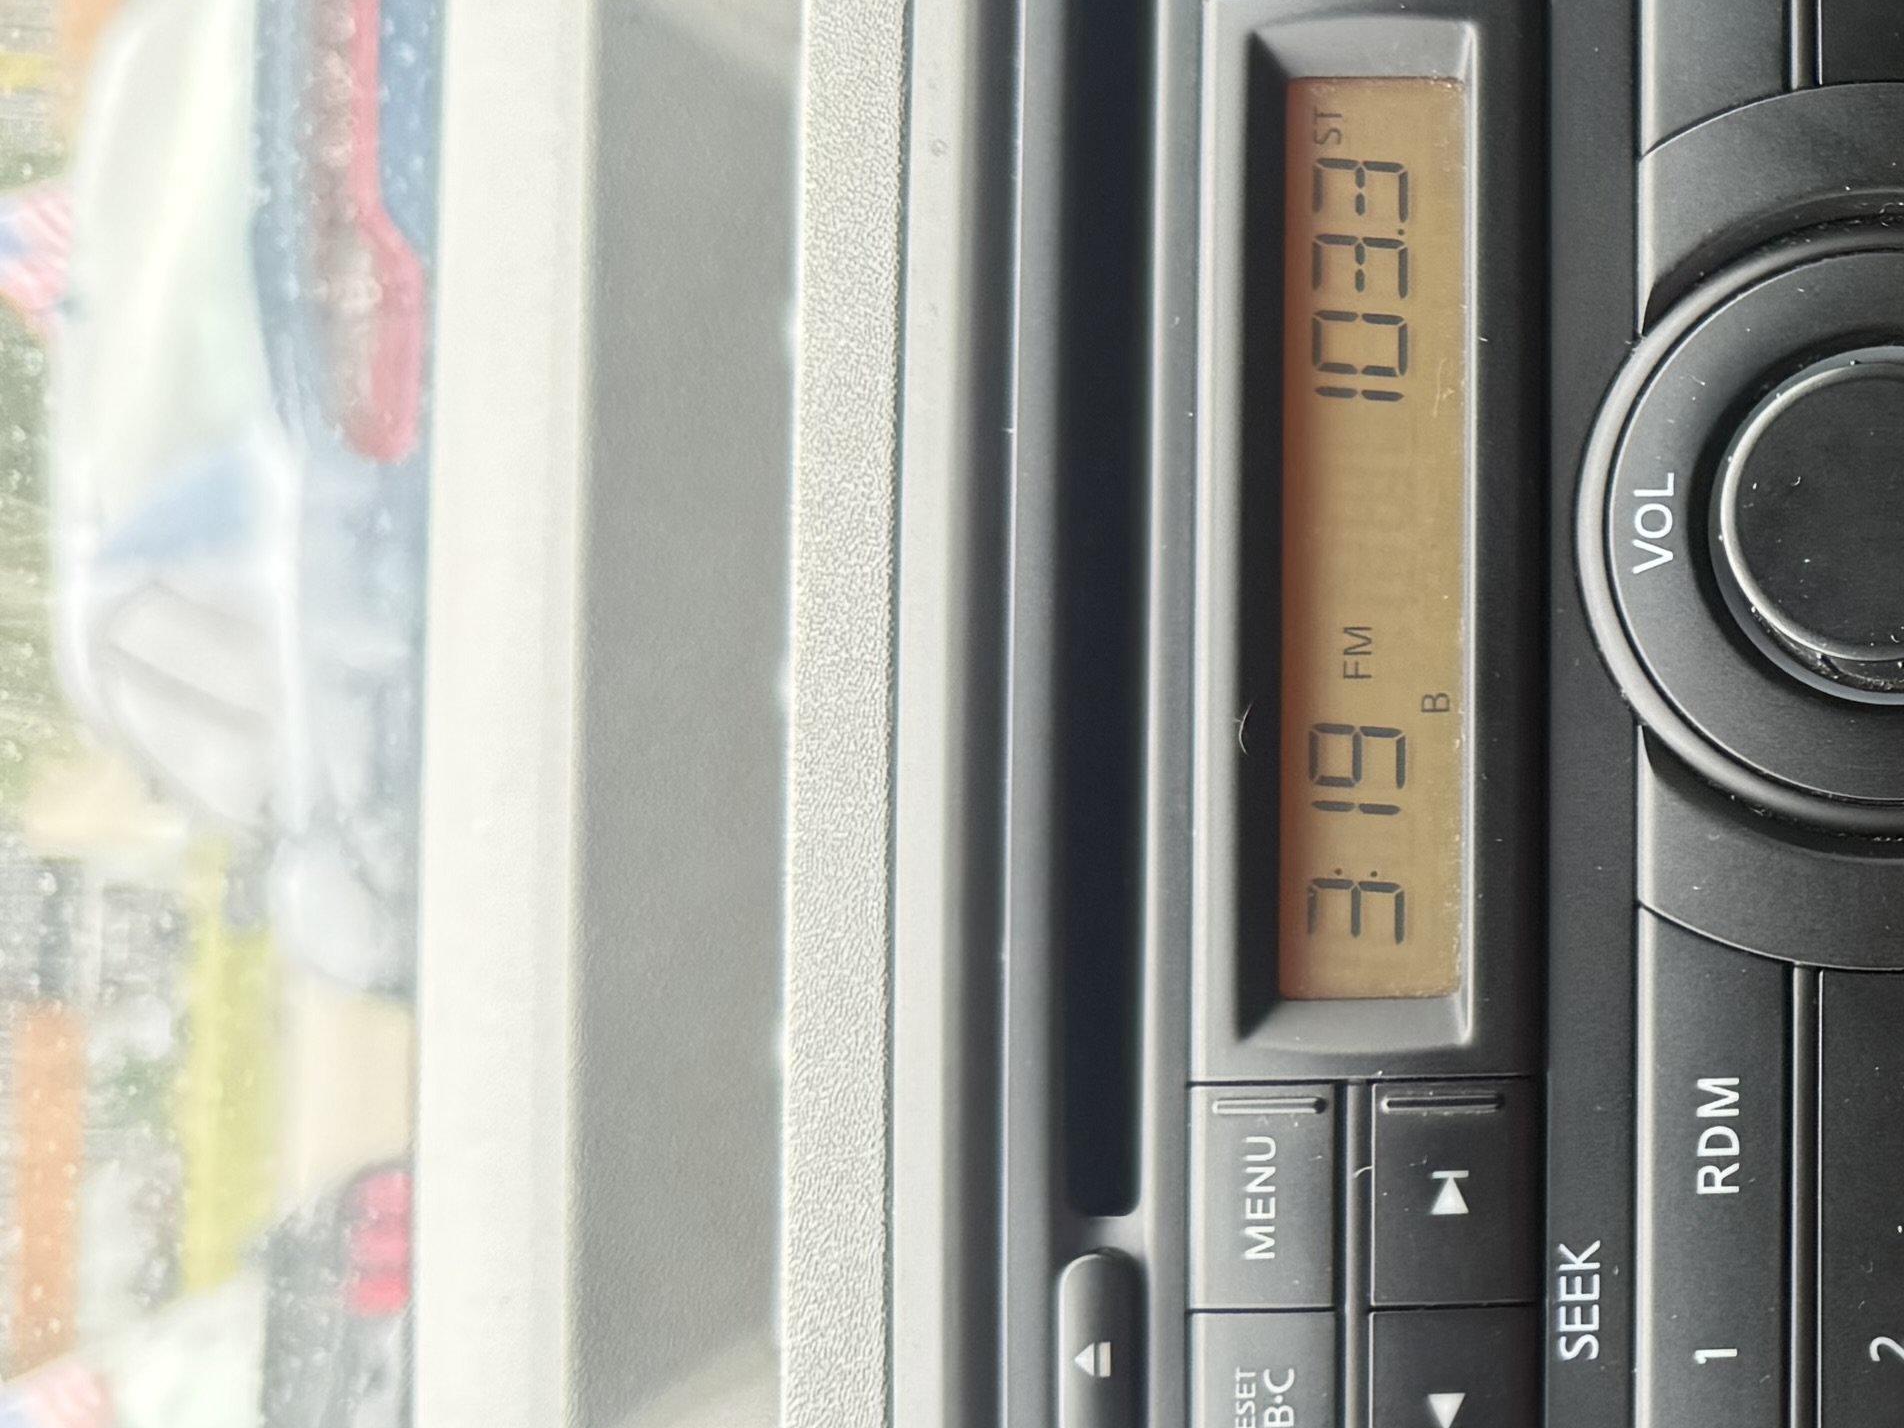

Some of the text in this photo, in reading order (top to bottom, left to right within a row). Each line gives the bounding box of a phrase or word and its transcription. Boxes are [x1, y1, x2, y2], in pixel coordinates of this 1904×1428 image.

[1307, 107, 1409, 945] 3:19 FM 103.3 ST
[1632, 473, 1674, 573] VOL
[1421, 693, 1449, 712] B
[1244, 1137, 1275, 1259] MENU
[1694, 1078, 1739, 1364] 1 RDM
[1559, 1241, 1600, 1359] SEEK
